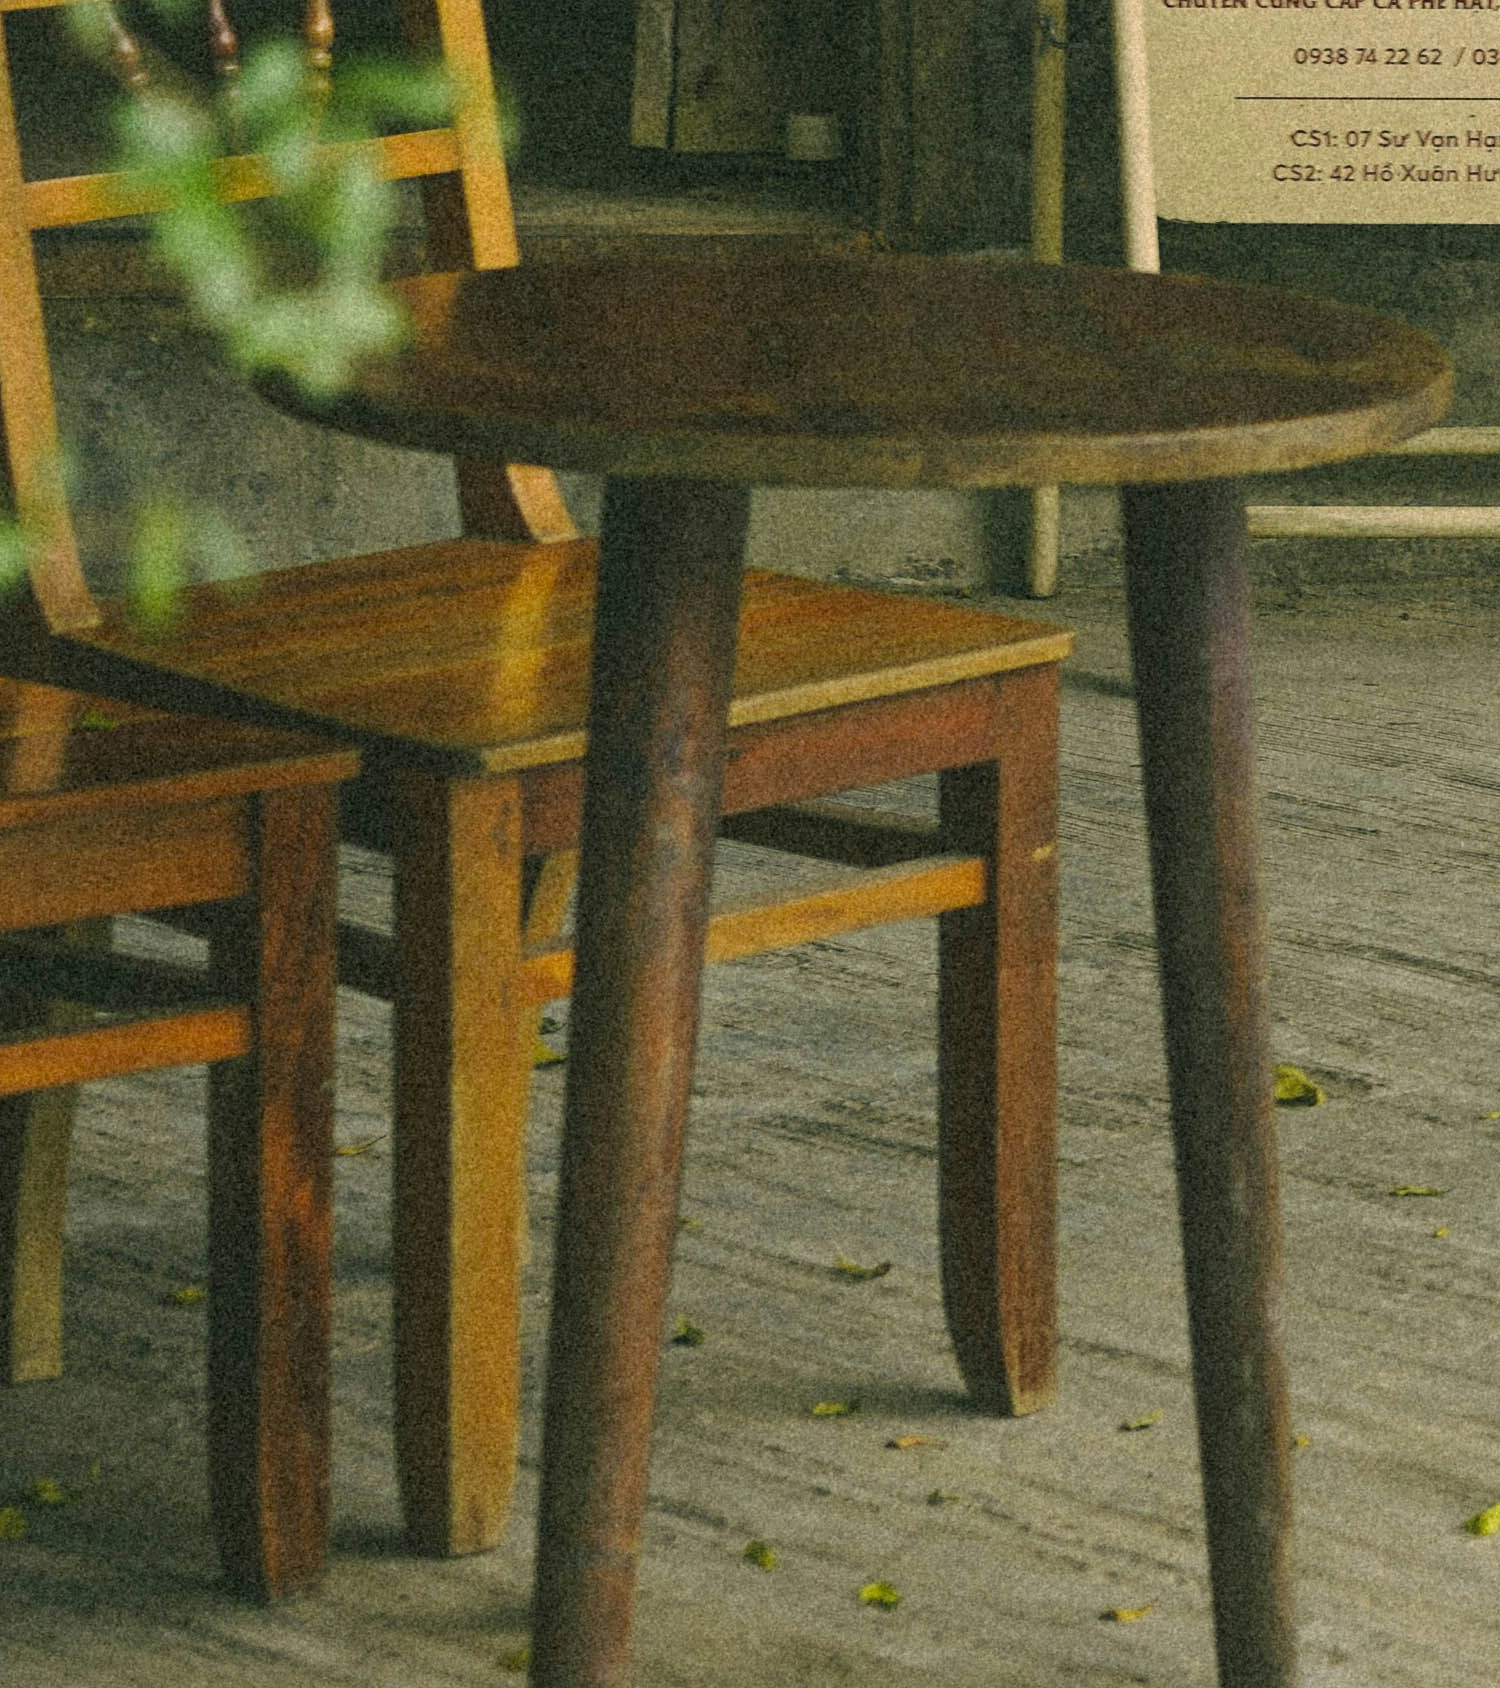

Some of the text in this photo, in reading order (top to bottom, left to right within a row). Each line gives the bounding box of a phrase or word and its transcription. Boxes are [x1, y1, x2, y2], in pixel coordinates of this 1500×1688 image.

[1294, 48, 1348, 64] 0938
[1355, 48, 1378, 64] 74
[1384, 48, 1410, 65] 22
[1417, 48, 1442, 65] 62
[1291, 130, 1338, 147] CS1:
[1345, 131, 1372, 147] 07
[1378, 131, 1409, 147] Sư
[1416, 131, 1458, 152] Vạn
[1273, 164, 1322, 181] CS2:
[1329, 165, 1355, 181] 42
[1400, 164, 1458, 181] Xuân
